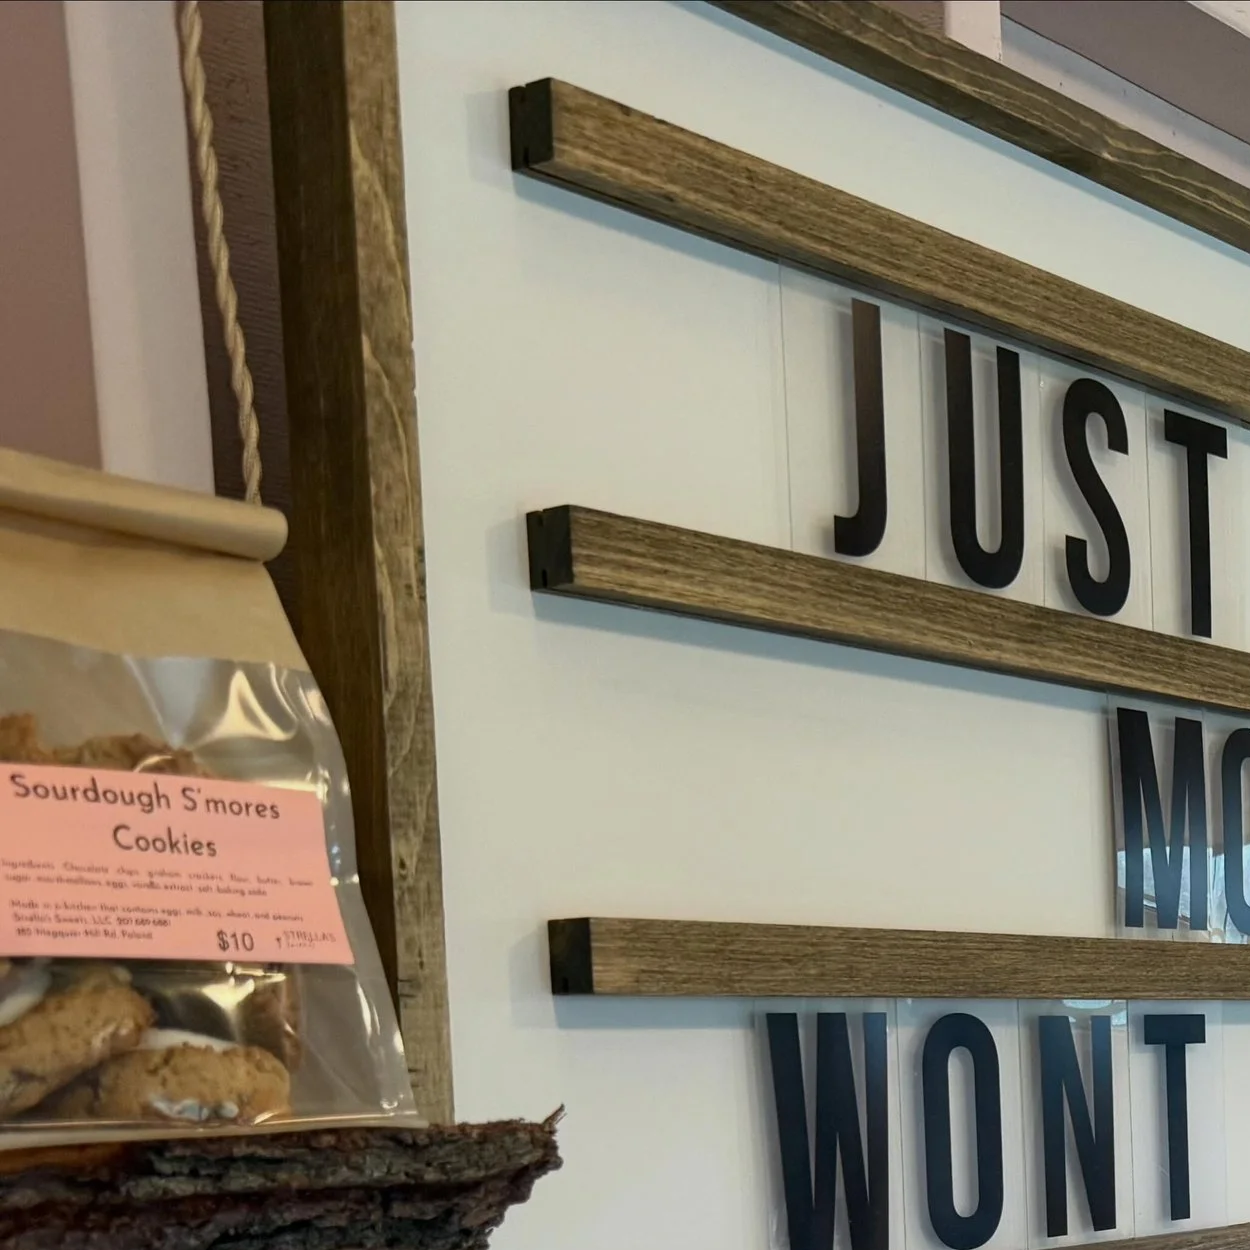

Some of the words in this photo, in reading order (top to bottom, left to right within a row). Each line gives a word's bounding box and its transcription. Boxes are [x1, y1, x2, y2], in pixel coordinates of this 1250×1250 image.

[834, 298, 1228, 638] JUST
[10, 773, 171, 814] Sourdough
[181, 786, 280, 820] S'mores
[113, 824, 217, 857] Cookies
[217, 929, 254, 952] $10
